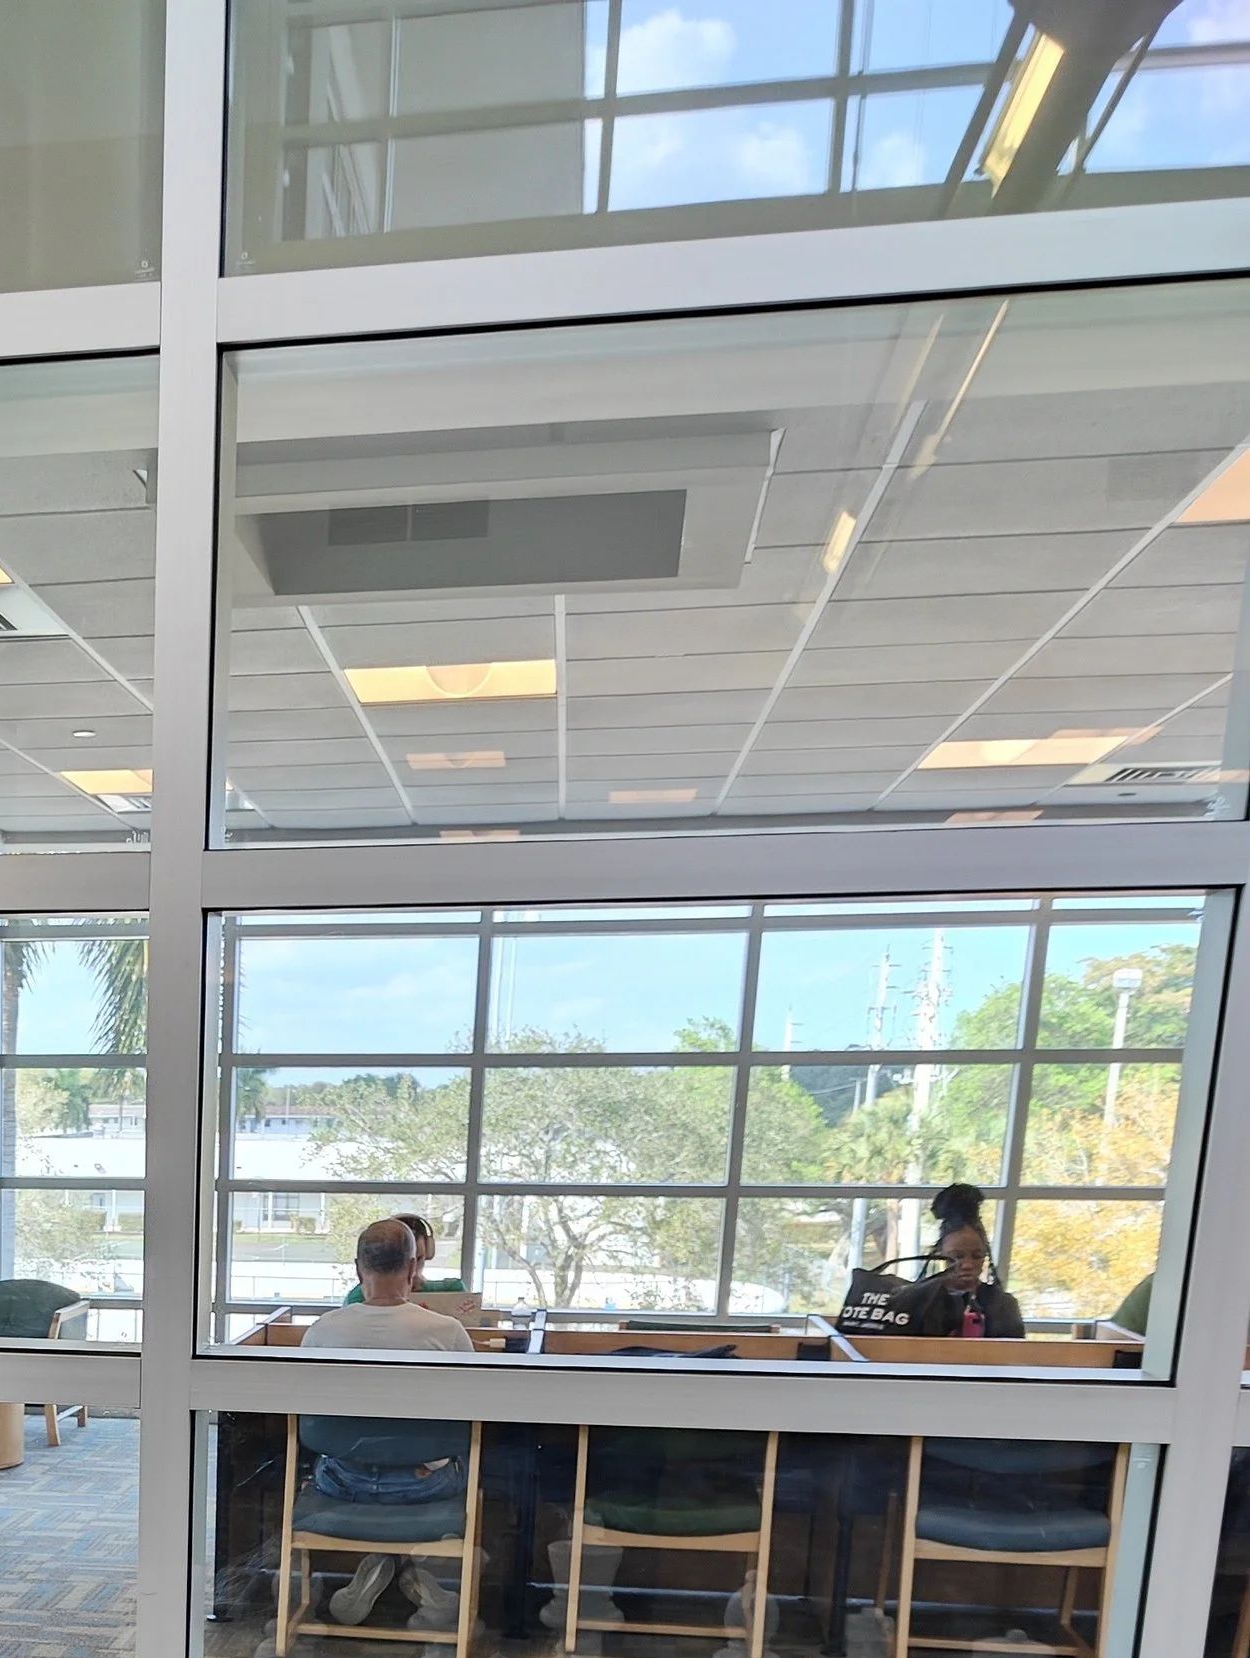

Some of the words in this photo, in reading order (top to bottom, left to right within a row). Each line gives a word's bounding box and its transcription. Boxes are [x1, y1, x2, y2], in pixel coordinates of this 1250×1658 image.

[861, 1292, 891, 1306] THE
[842, 1306, 870, 1319] OTE
[870, 1307, 910, 1325] BAG
